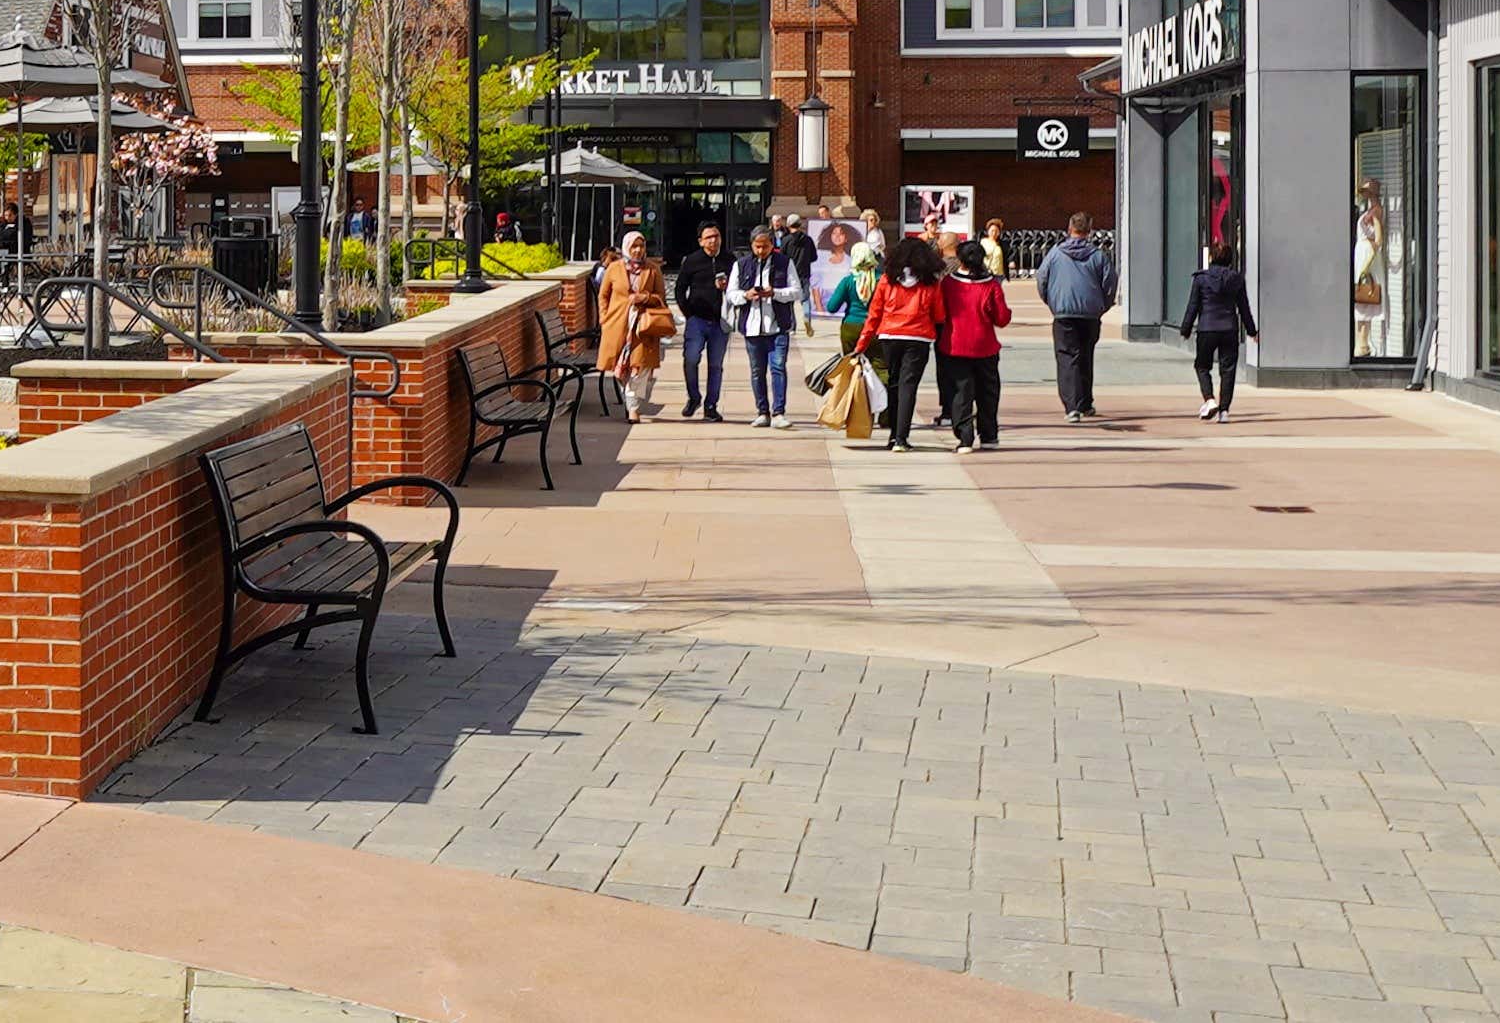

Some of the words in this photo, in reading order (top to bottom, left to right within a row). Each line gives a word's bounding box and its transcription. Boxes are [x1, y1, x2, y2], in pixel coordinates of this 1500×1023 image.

[1128, 14, 1180, 92] MICHAEL
[510, 64, 630, 95] MRKET
[637, 63, 720, 95] HALL
[1024, 149, 1058, 158] MICHAEL
[1059, 149, 1080, 158] KORS
